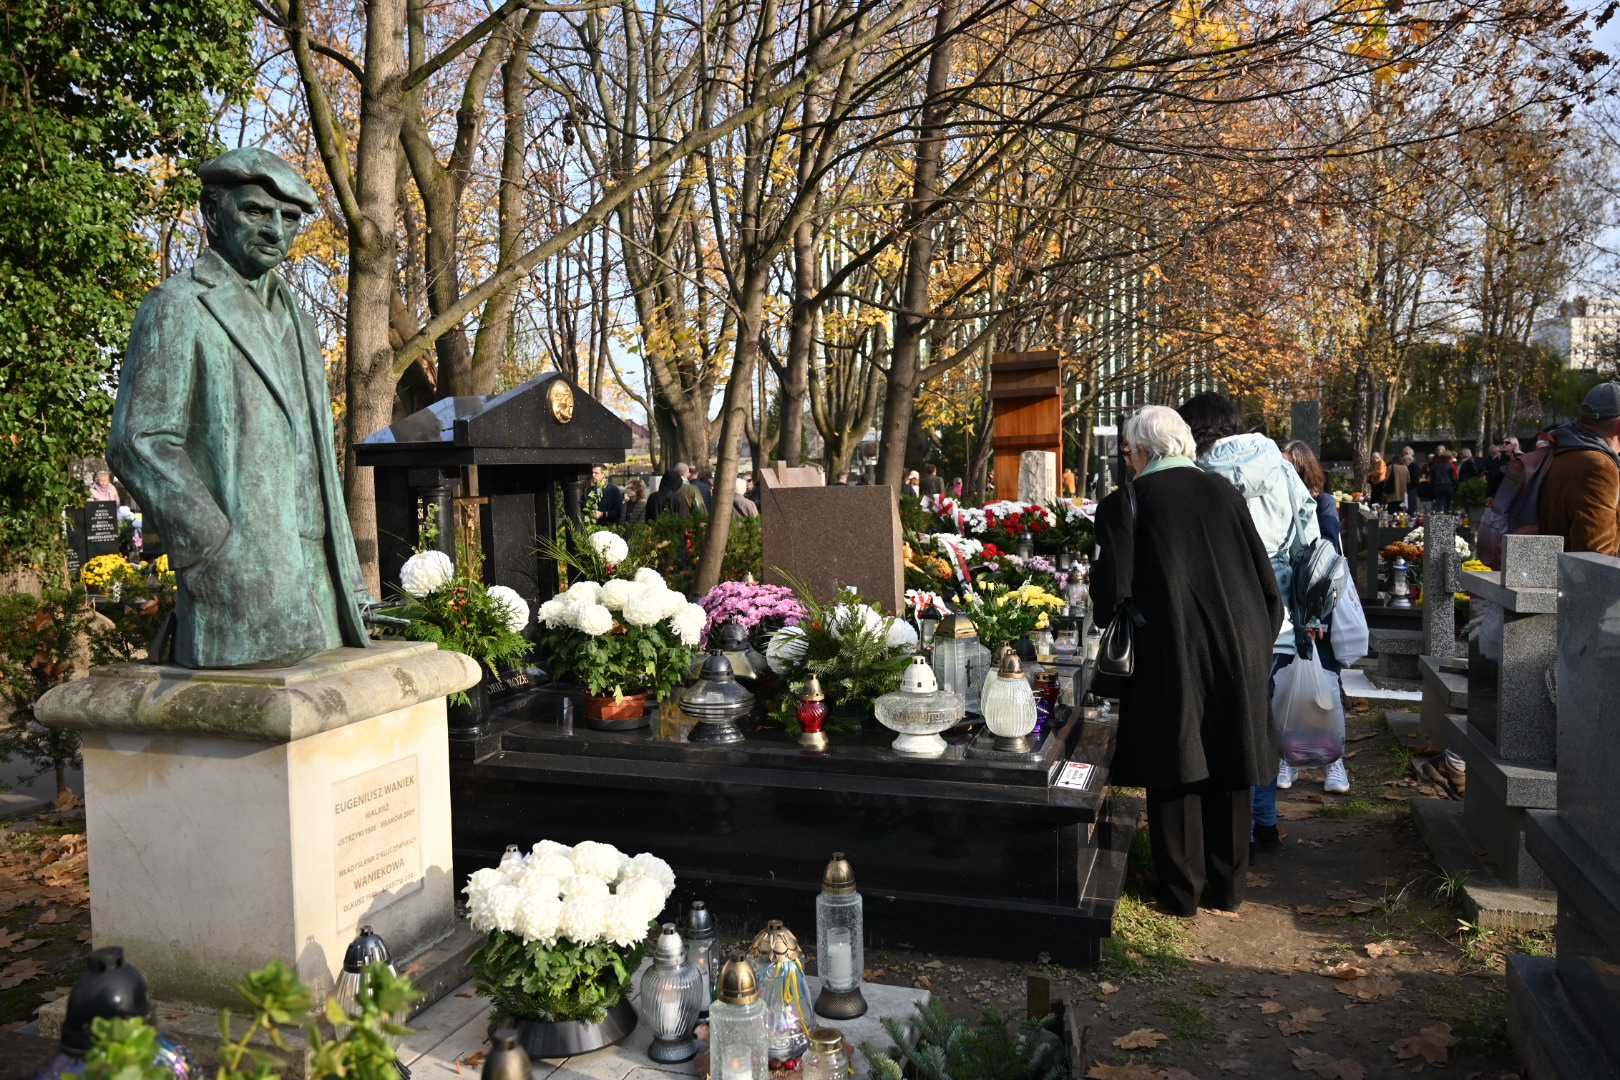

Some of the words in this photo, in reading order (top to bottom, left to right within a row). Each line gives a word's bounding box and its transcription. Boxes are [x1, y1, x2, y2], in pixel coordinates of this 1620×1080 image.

[486, 681, 506, 694] OBIE
[334, 787, 383, 814] EUGENIUSZ
[384, 775, 414, 795] WANIEK
[365, 804, 390, 819] MALARZ
[338, 830, 364, 846] USTRZYKI
[338, 856, 375, 877] WŁADYSŁAWA
[380, 836, 416, 857] KLUCZEWSKICH
[354, 858, 405, 890] WANIEKOWA
[344, 897, 365, 912] OLKUSZ
